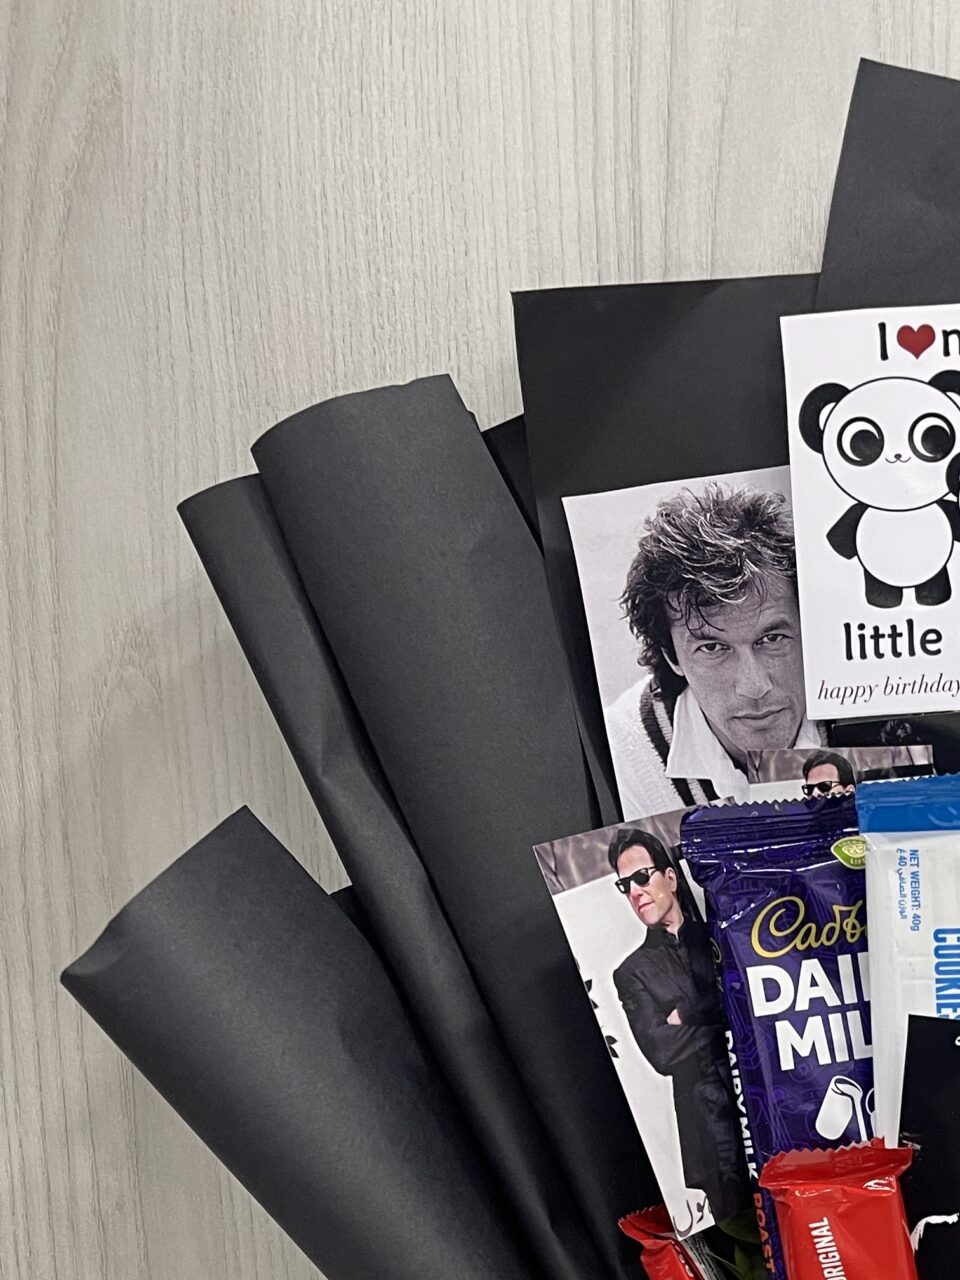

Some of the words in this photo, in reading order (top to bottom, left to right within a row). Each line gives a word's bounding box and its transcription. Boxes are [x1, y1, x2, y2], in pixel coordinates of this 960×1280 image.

[878, 322, 889, 361] I
[843, 617, 943, 661] little
[817, 678, 880, 703] happy
[897, 855, 907, 867] 40
[909, 849, 920, 869] NET
[910, 870, 921, 911] WEIGHT:
[910, 913, 922, 932] 40g
